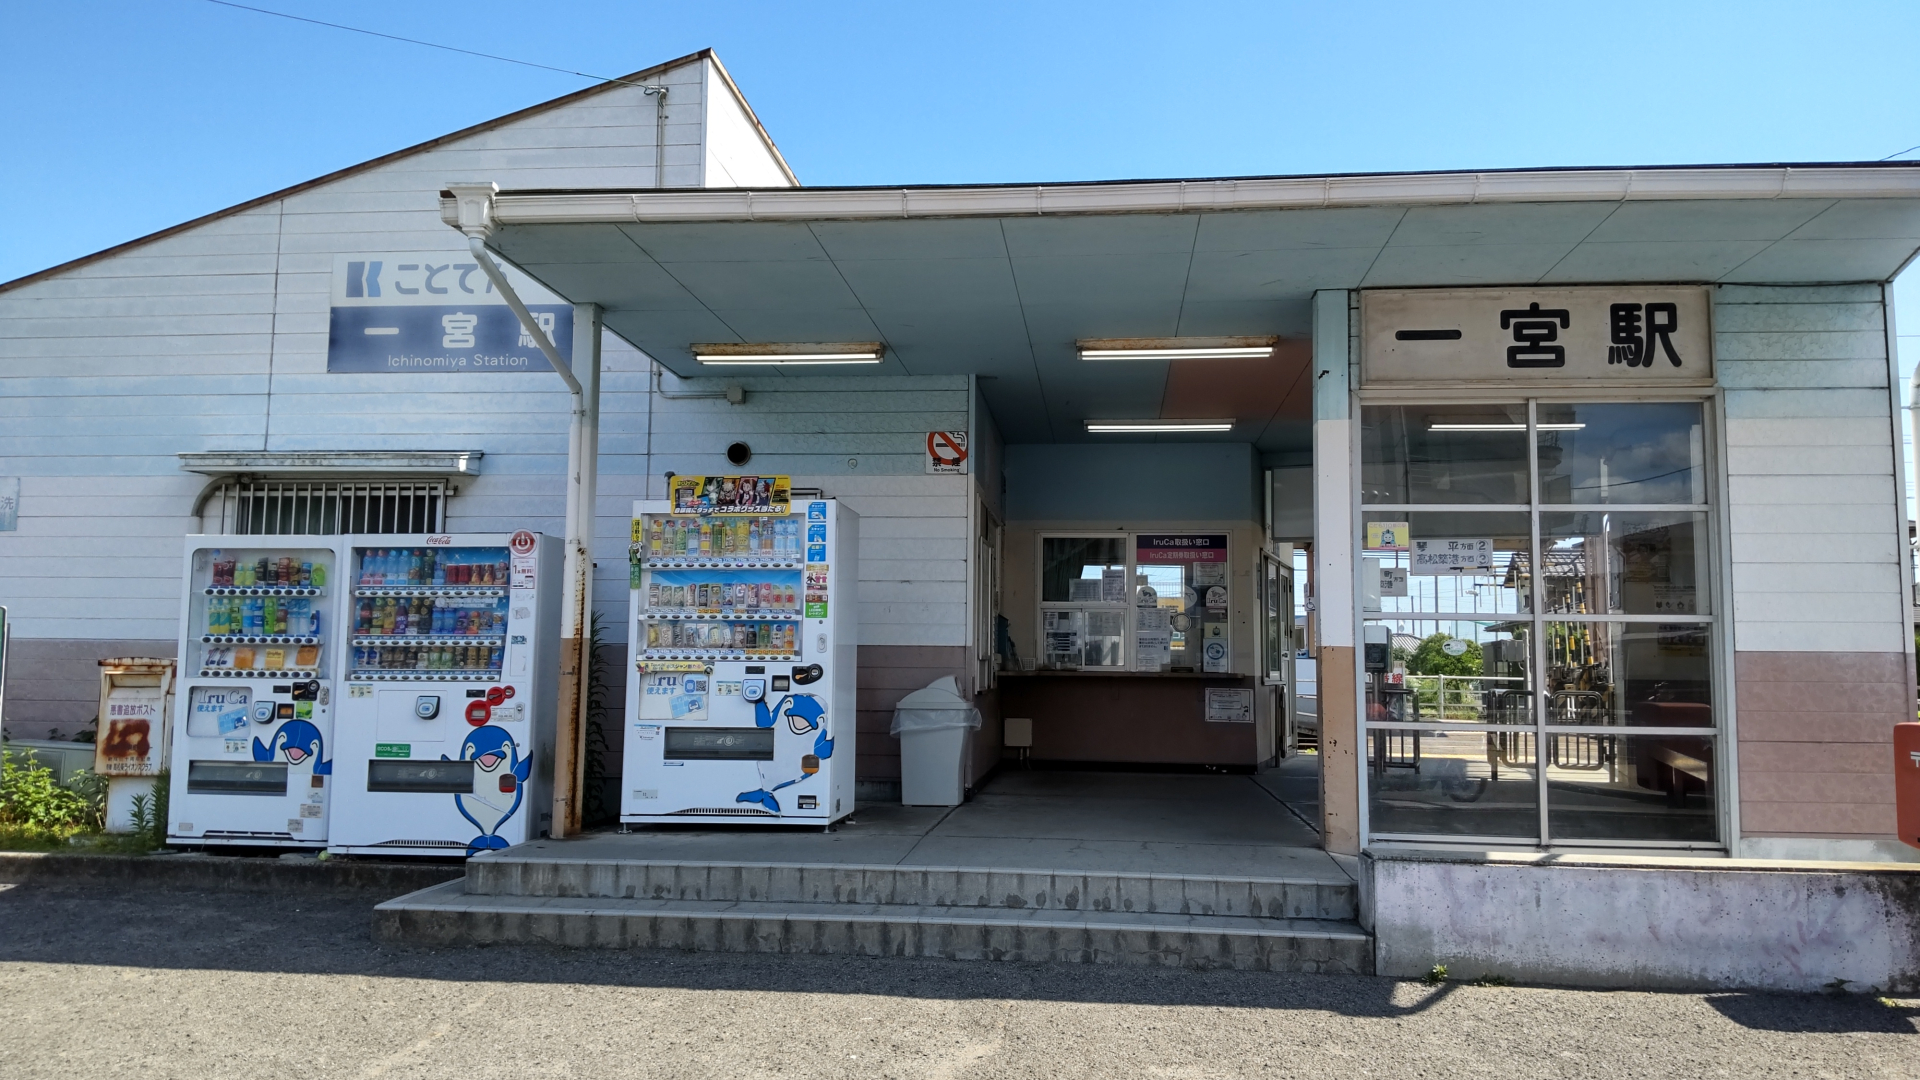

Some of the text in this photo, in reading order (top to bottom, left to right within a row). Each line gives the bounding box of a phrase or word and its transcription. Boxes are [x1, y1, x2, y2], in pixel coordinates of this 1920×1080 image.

[1395, 302, 1682, 368] 一宮駅
[388, 353, 528, 368] Ichinomiya Station
[932, 457, 960, 467] 禁煙
[1153, 538, 1210, 546] IruCa取扱い窓口
[647, 672, 693, 686] IruC
[197, 689, 248, 705] IruCa
[646, 687, 677, 695] 使えます
[110, 704, 156, 716] 悪書追放ポスト
[196, 704, 225, 713] 使えます
